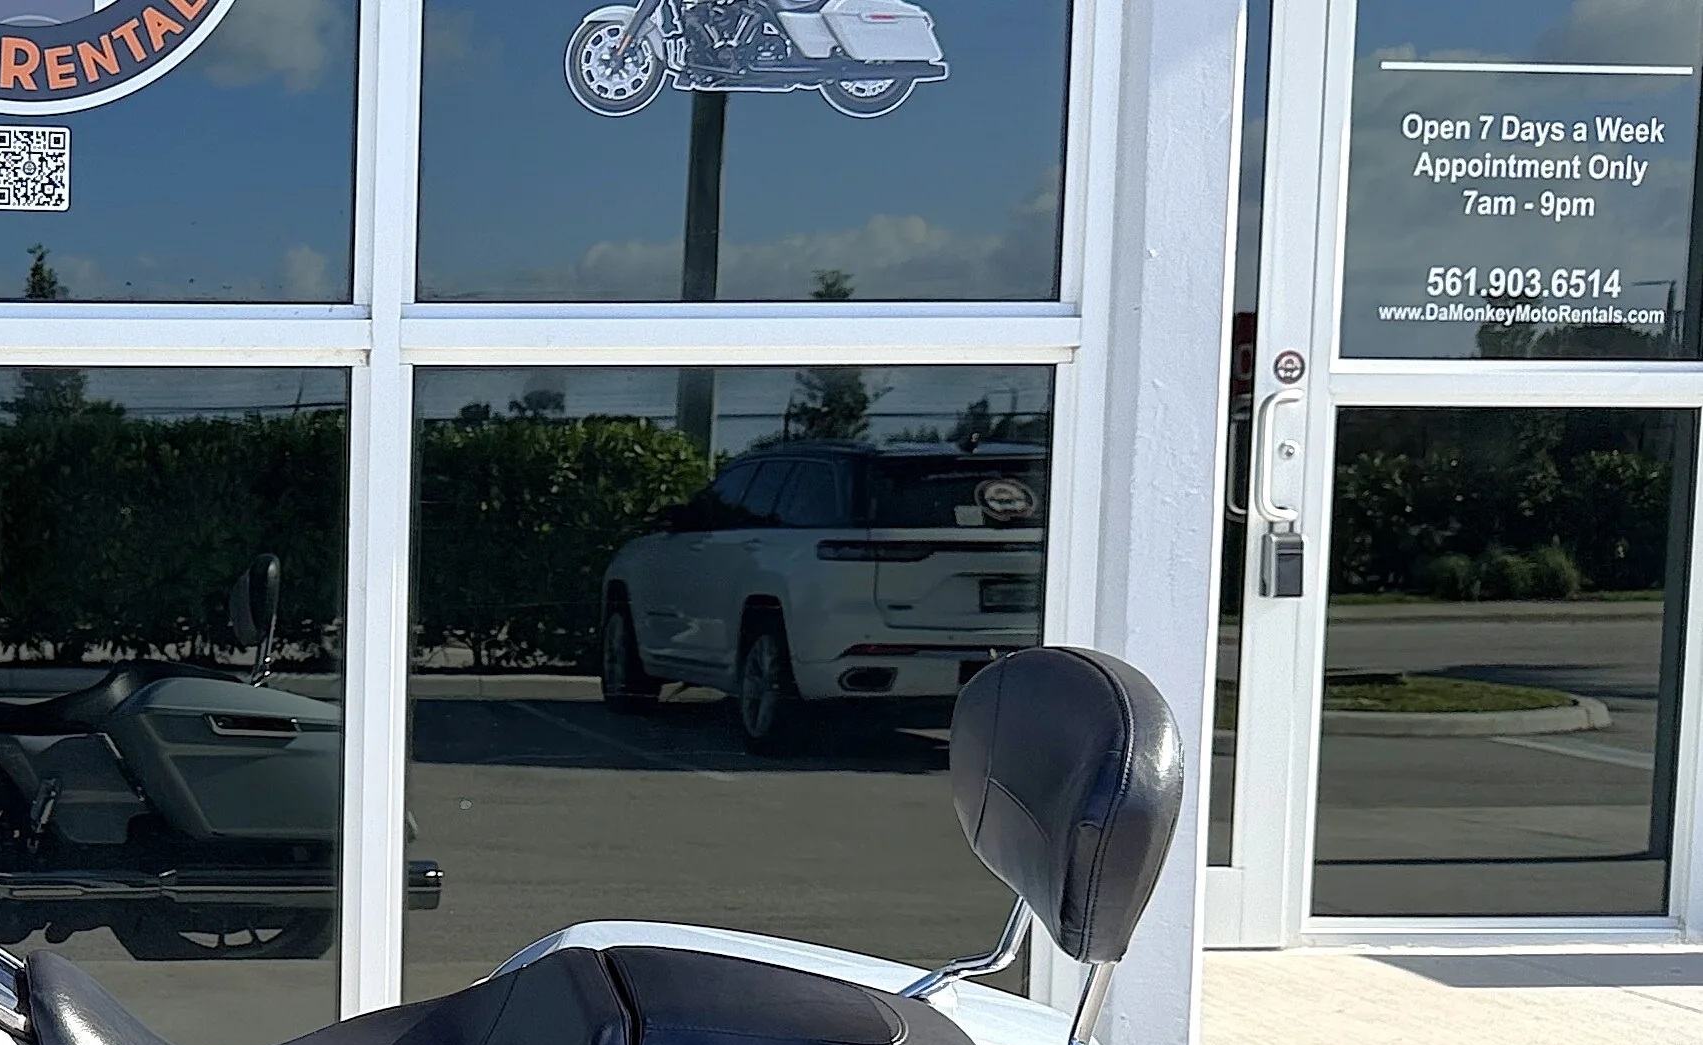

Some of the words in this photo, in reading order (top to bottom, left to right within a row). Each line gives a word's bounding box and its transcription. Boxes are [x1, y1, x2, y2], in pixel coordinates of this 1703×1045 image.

[1402, 113, 1471, 145] Open
[1479, 115, 1495, 140] 7
[1501, 115, 1565, 147] Days
[1572, 122, 1588, 142] a
[1596, 116, 1665, 143] Week
[1413, 151, 1582, 183] Appointment
[1588, 154, 1649, 186] Only
[1463, 190, 1516, 216] 7am
[1540, 191, 1595, 222] 9pm
[1427, 267, 1622, 299] 561.903.6514
[1378, 303, 1665, 326] www.DaMonkeyMotoRentals.com
